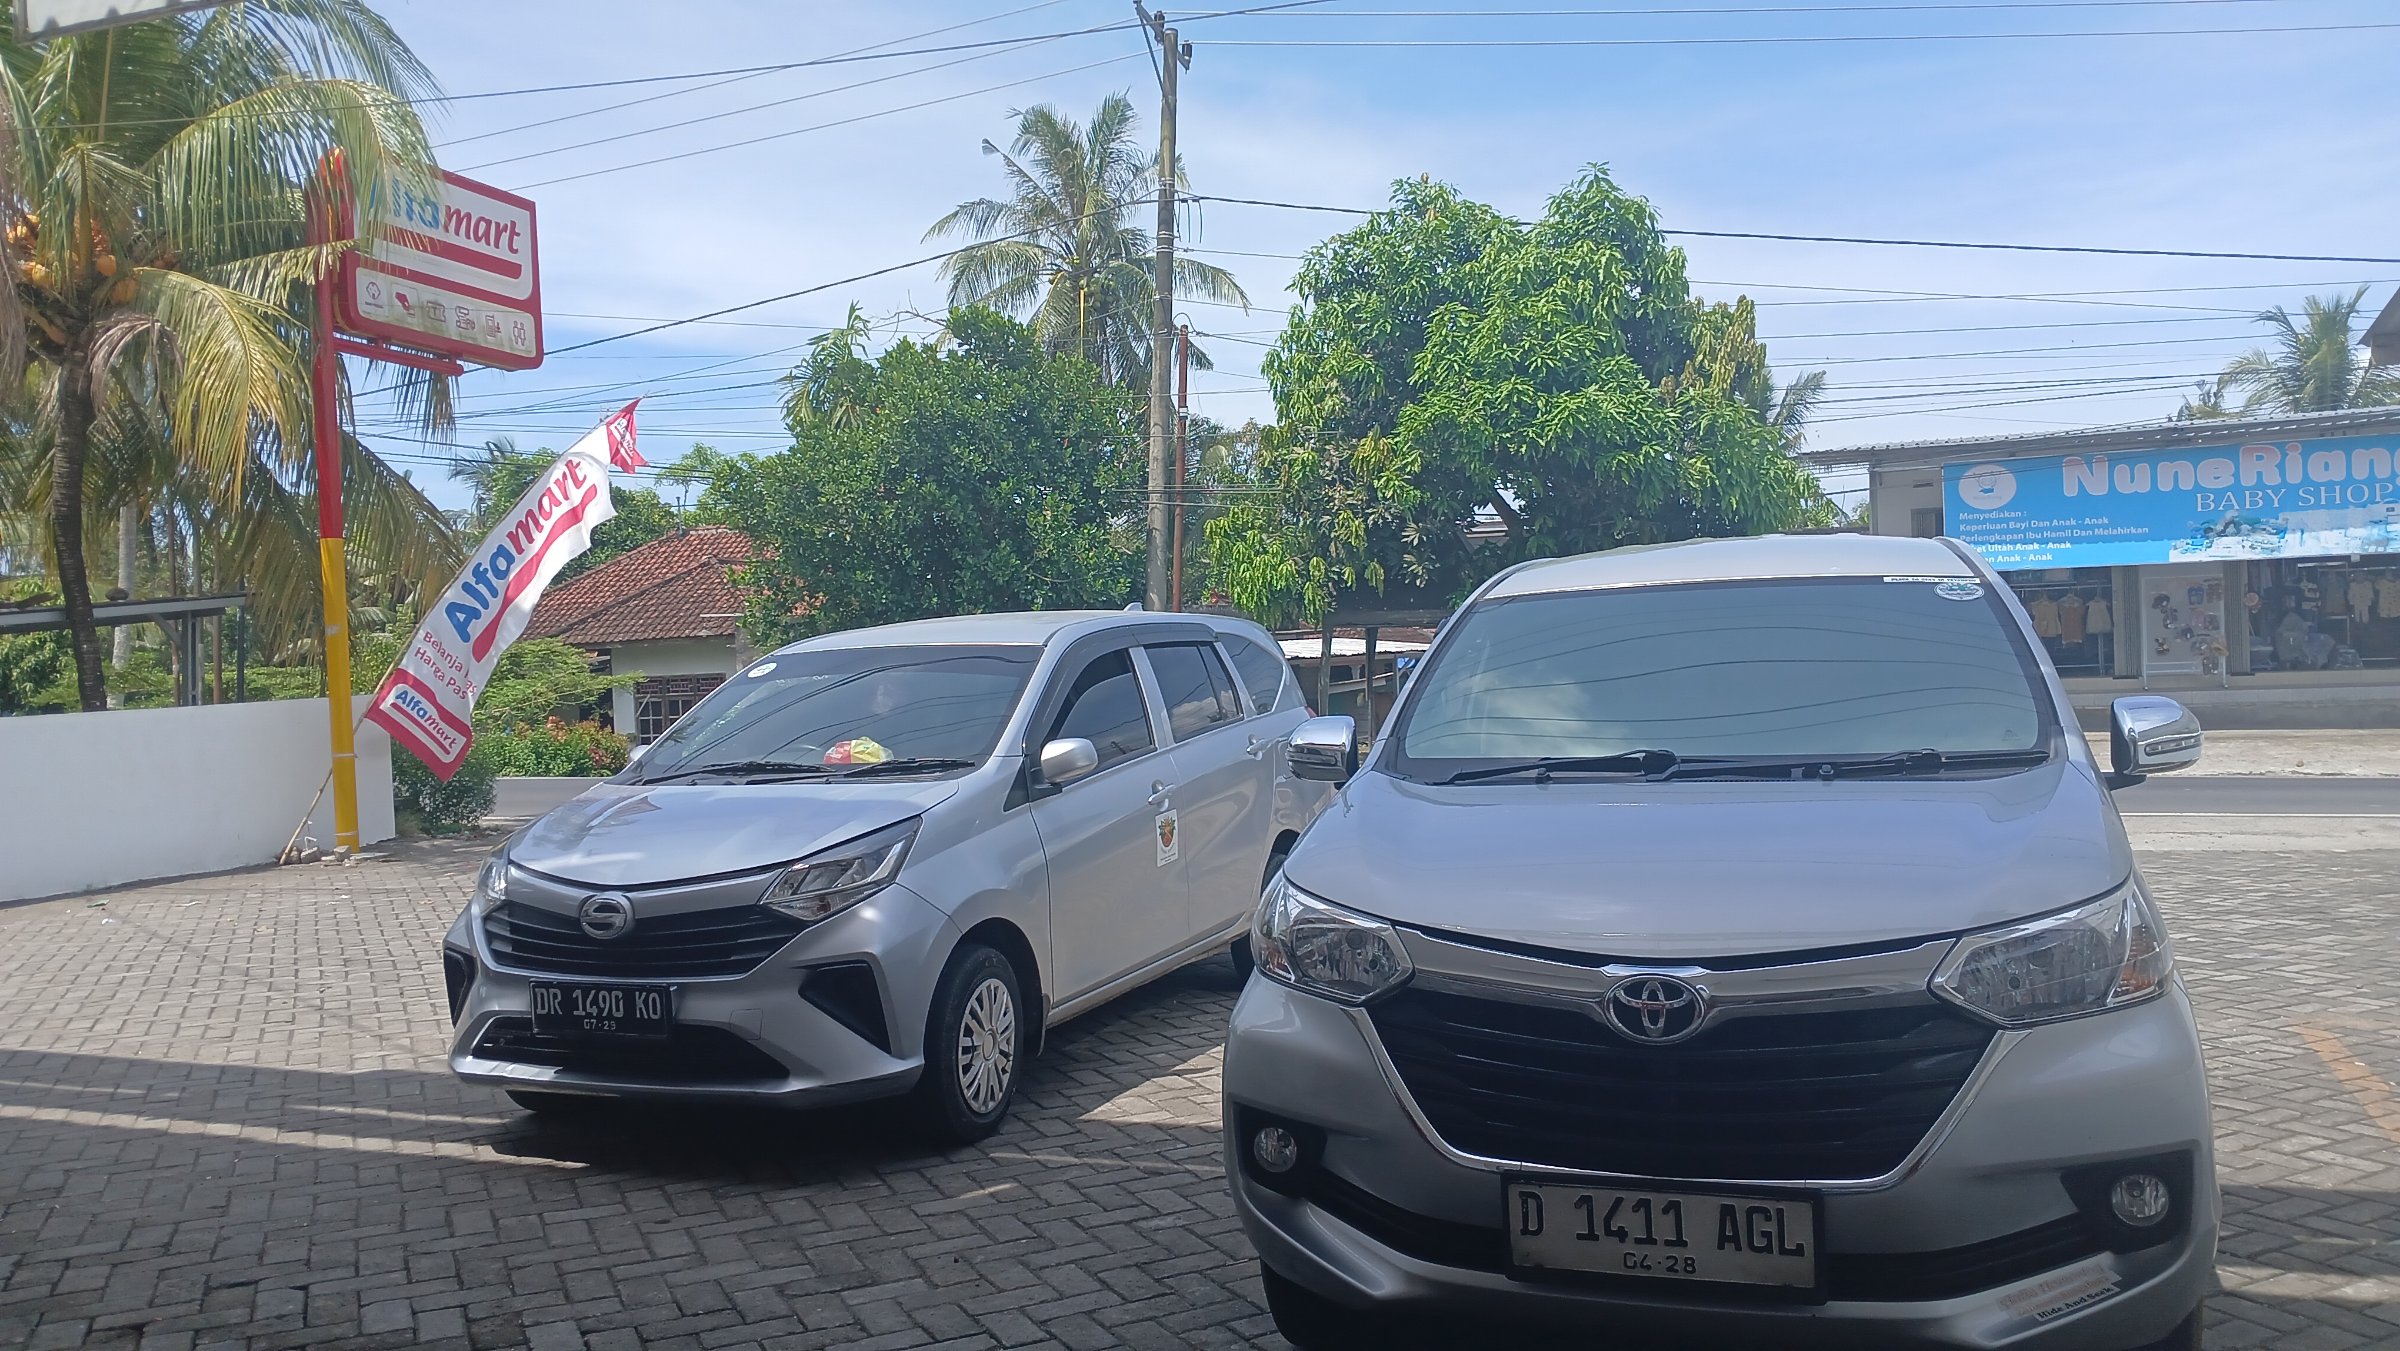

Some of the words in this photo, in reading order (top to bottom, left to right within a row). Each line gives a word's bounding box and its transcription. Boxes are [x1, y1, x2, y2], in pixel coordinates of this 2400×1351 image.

[2062, 442, 2400, 497] NuneRian
[2196, 488, 2287, 512] BABY
[2298, 482, 2393, 507] SHOP
[1960, 521, 2007, 532] Keperluan
[2009, 520, 2029, 530] Bayi
[2031, 520, 2050, 528] Dan
[2052, 518, 2076, 527] Anak
[2084, 516, 2109, 525] Anak
[1960, 532, 2024, 543] Perlengkapan
[2026, 531, 2042, 539] Ibu
[2043, 529, 2071, 538] Hamil
[2073, 529, 2093, 537] Dan
[2094, 526, 2149, 536] Melahirkan
[445, 459, 587, 643] Alfamart
[1988, 543, 2014, 553] Ultah
[2015, 542, 2040, 551] Anak
[2046, 541, 2072, 550] Anak
[1996, 554, 2021, 563] Anak
[2028, 552, 2053, 561] Anak
[423, 631, 463, 673] Belanja
[414, 646, 446, 683] Harga
[446, 676, 468, 700] Pas
[394, 689, 458, 749] Alfamart
[534, 987, 563, 1015] DR
[572, 988, 625, 1018] 1490
[634, 990, 662, 1020] KO
[1518, 1190, 1545, 1237] D
[1573, 1193, 1689, 1248] 1411
[1716, 1202, 1806, 1257] AGL
